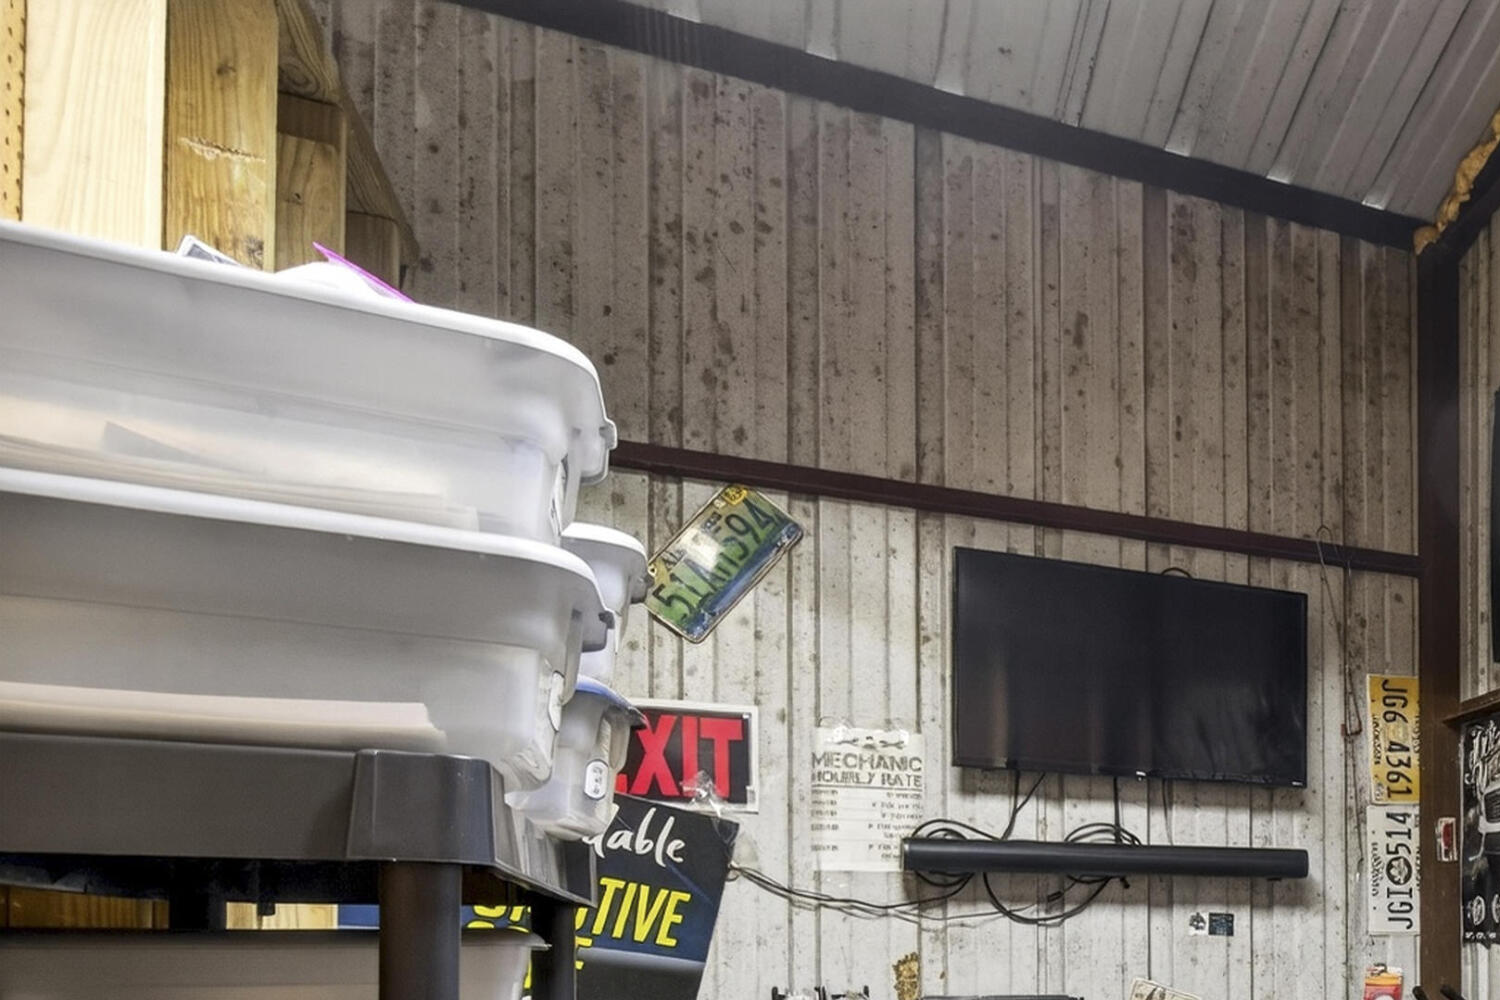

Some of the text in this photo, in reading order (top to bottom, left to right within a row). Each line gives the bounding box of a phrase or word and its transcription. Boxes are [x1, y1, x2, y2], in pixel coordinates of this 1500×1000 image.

[614, 714, 743, 798] XIT
[811, 752, 922, 772] MECHANIC
[881, 773, 922, 787] RATE
[1381, 679, 1413, 798] JG6 4361
[1386, 812, 1413, 930] JGI 514
